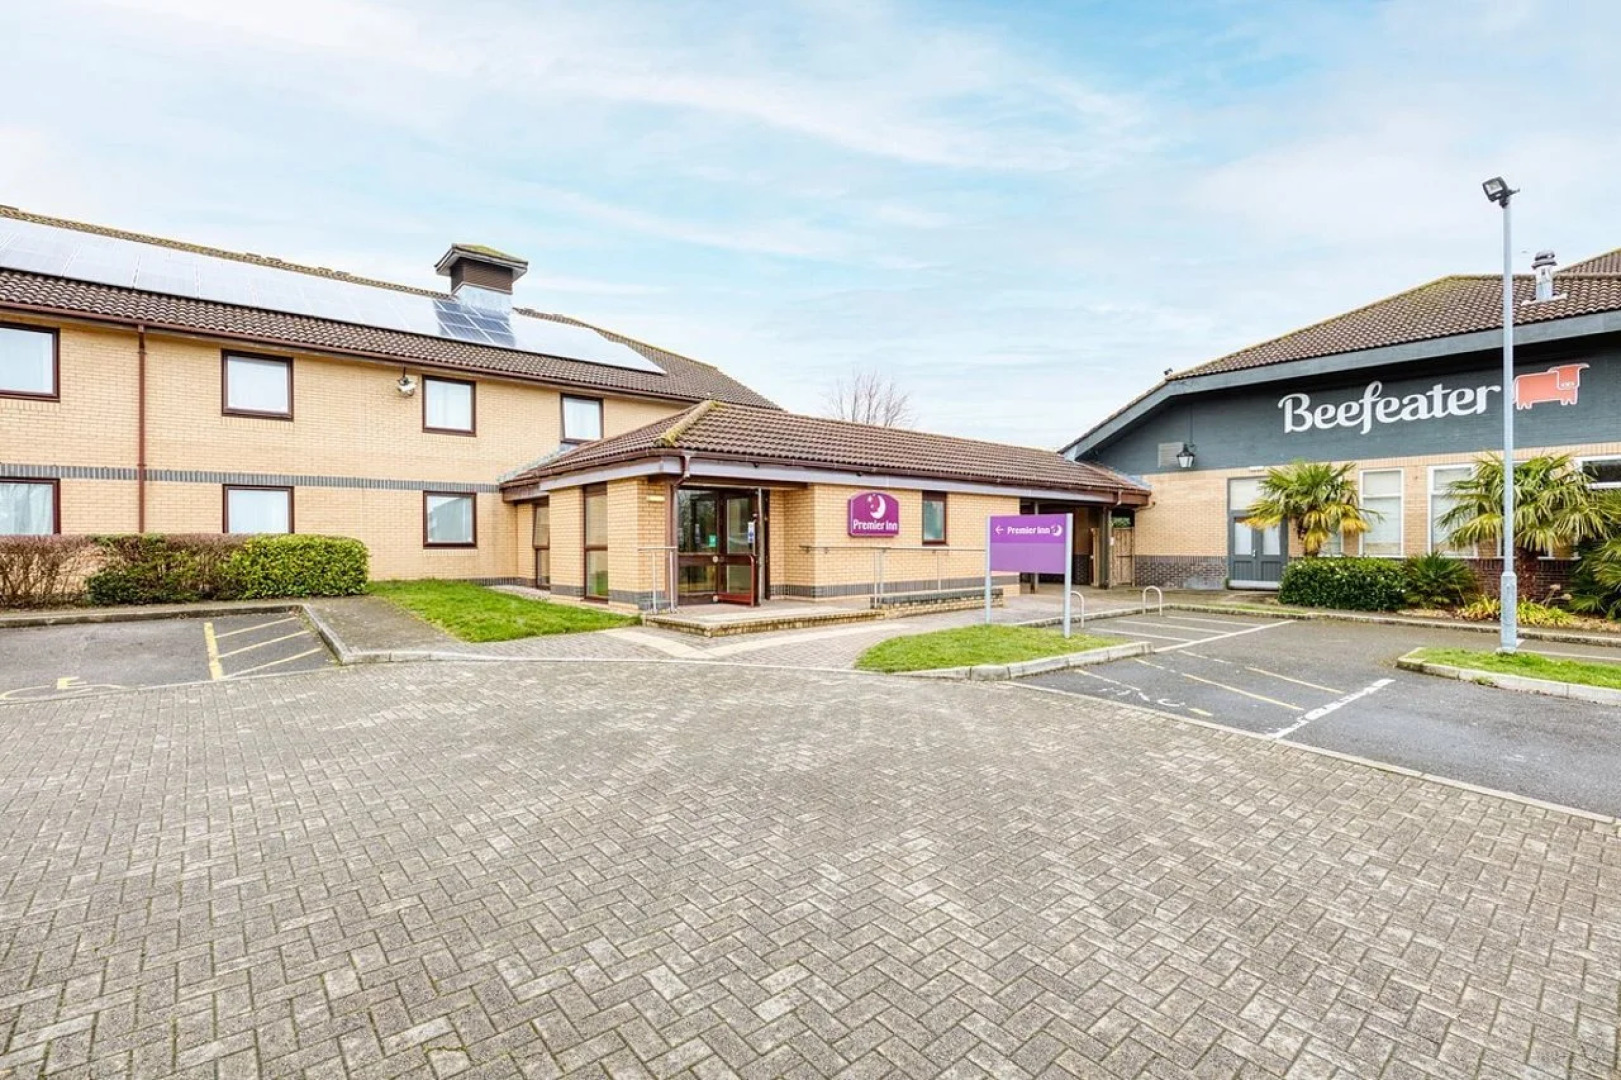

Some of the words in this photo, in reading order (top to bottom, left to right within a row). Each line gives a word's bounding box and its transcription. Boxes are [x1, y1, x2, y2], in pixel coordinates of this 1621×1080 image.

[1277, 380, 1501, 435] Beefeater
[853, 518, 884, 530] Premier
[885, 520, 897, 531] Inn
[1007, 526, 1037, 535] Premier
[1037, 526, 1051, 534] Inn
